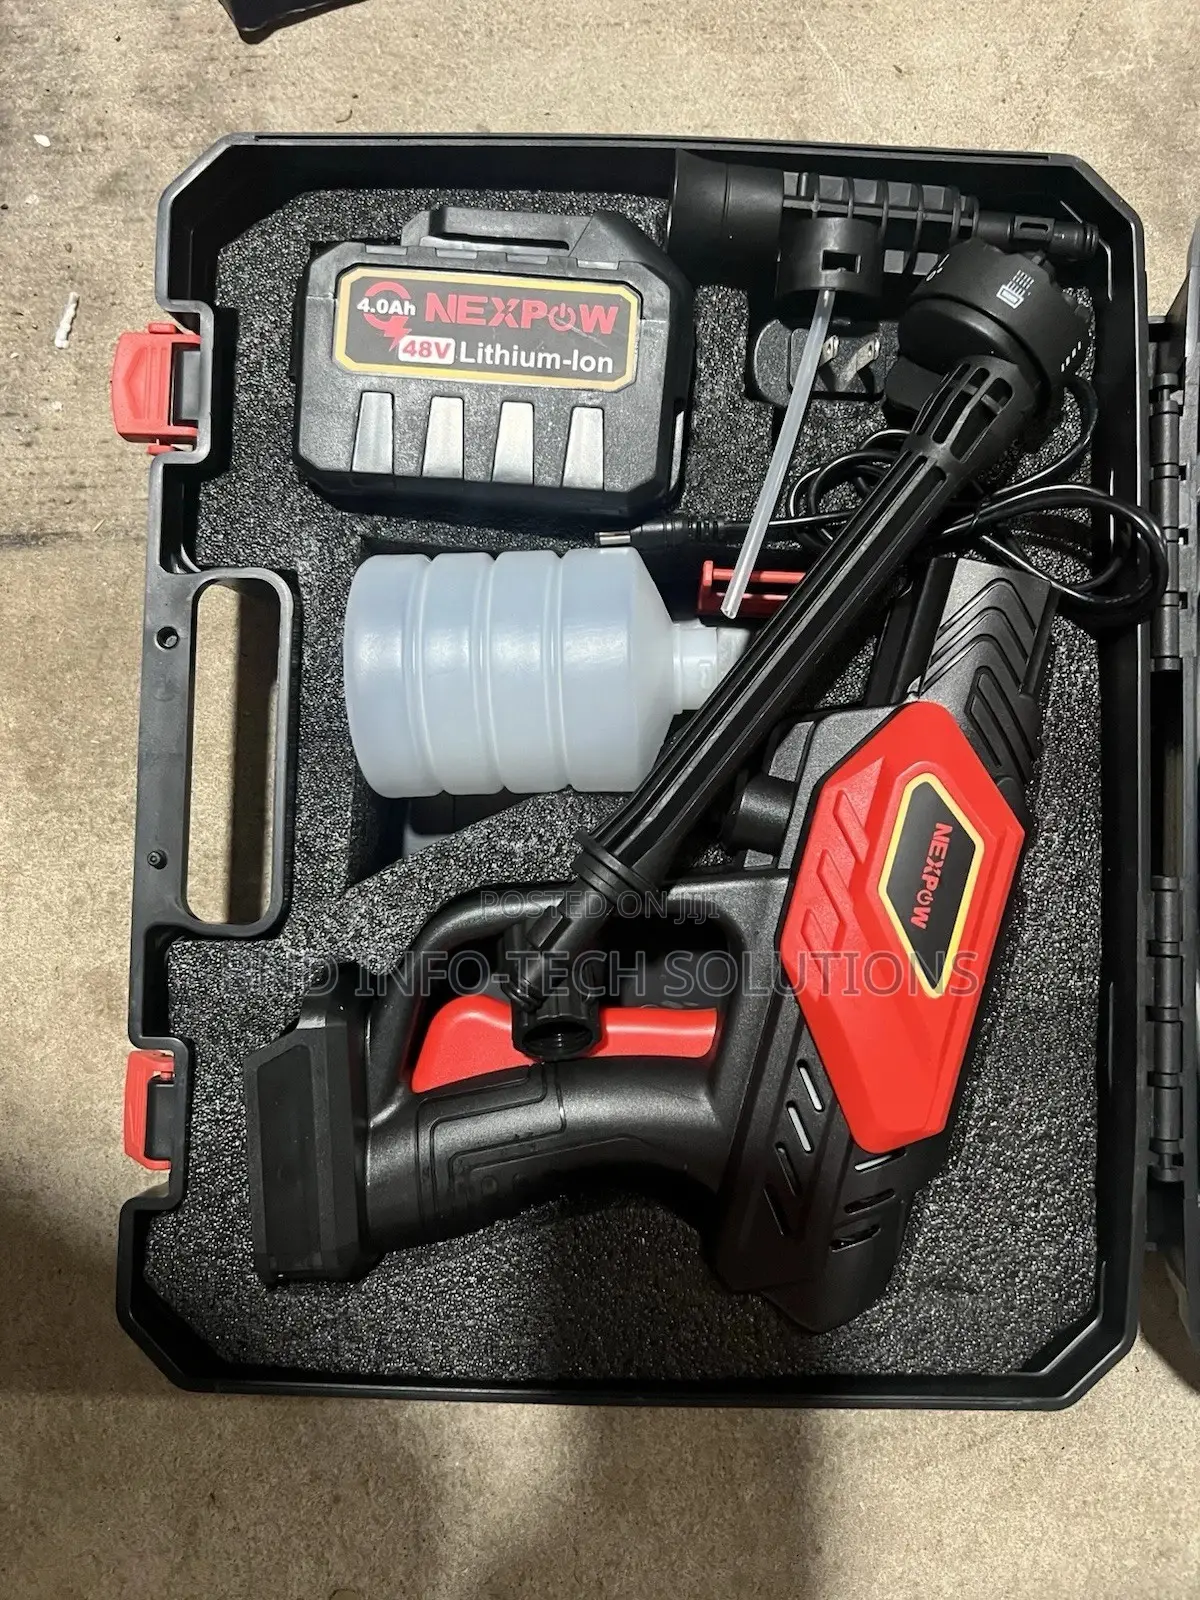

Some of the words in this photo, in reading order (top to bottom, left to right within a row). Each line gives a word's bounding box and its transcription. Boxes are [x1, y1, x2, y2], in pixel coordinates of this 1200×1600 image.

[356, 297, 416, 316] 4.0Ah
[424, 292, 619, 334] NEXPOW
[402, 339, 451, 359] 48V
[459, 341, 614, 374] Lithium-Ion
[910, 822, 953, 930] NEXPOW
